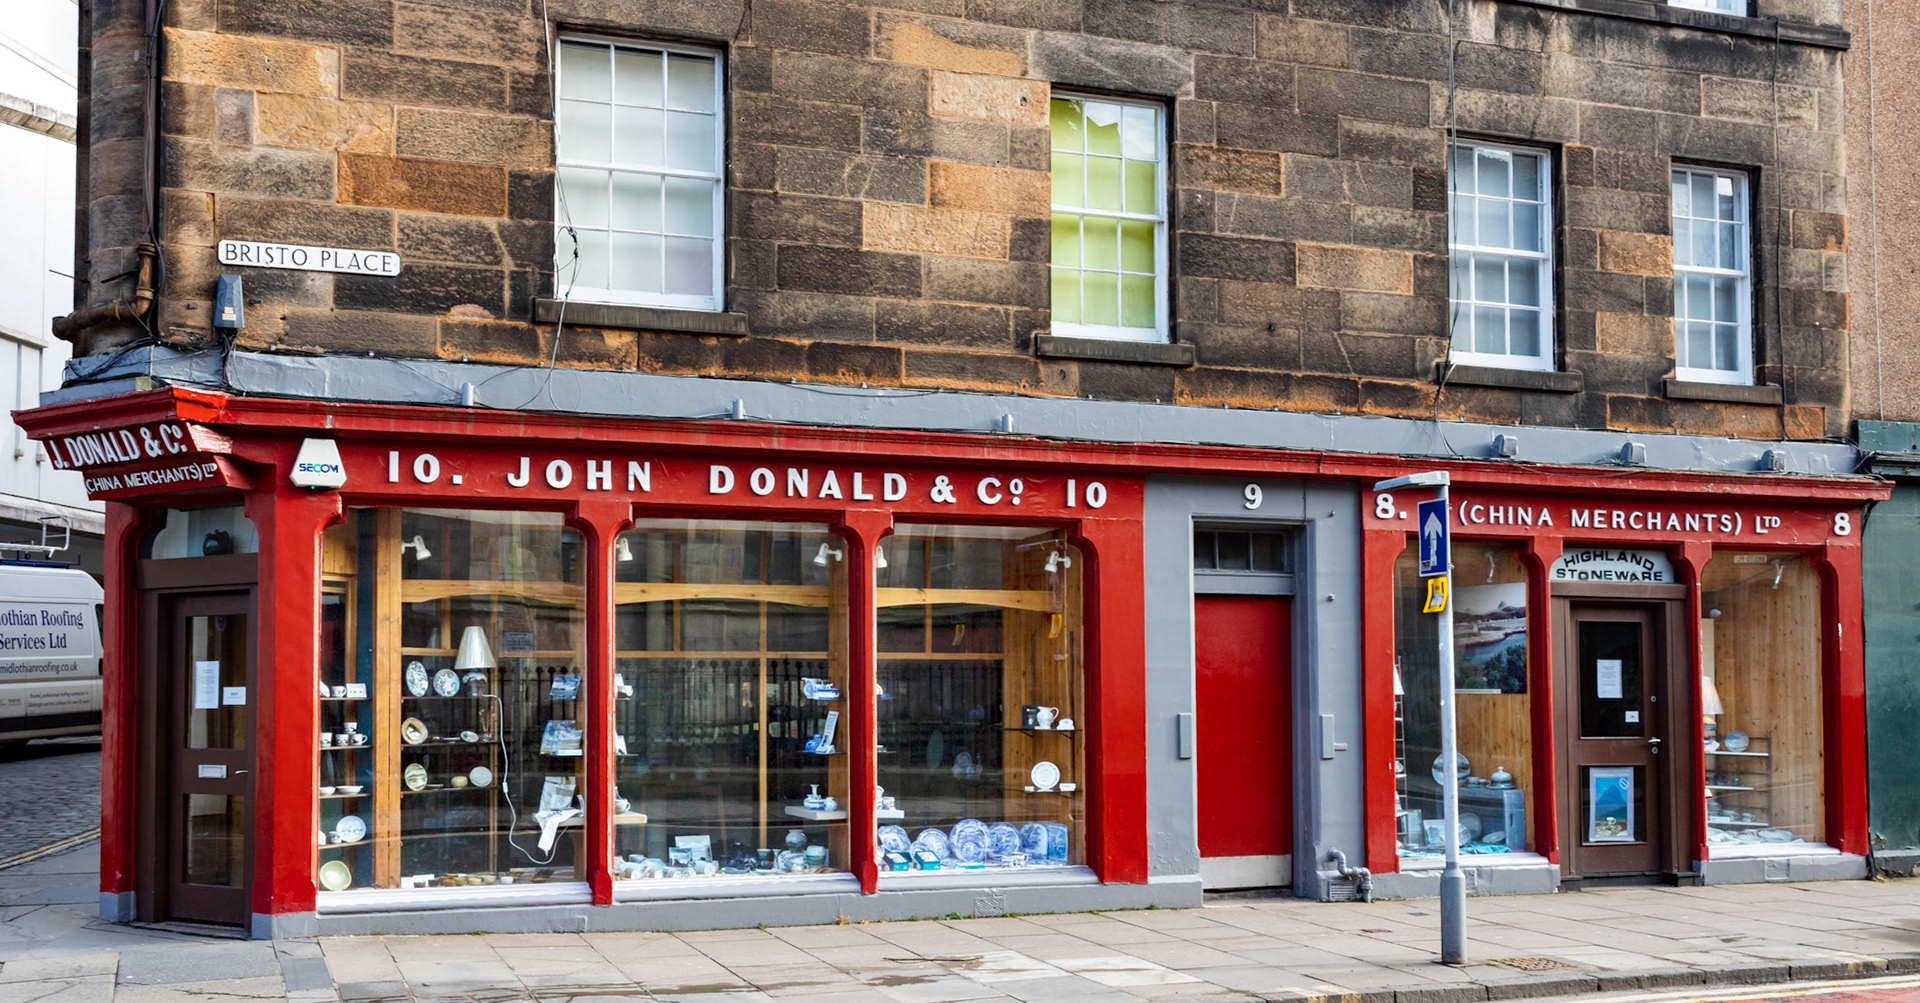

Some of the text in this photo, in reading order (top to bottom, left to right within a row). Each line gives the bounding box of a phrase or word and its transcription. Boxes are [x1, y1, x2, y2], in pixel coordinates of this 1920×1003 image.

[225, 243, 392, 272] BRISTO PLACE
[50, 440, 70, 469] J.
[64, 429, 141, 467] DONALD
[140, 426, 163, 458] &
[84, 476, 122, 494] (CHINA
[123, 462, 201, 488] MERCHANTS)
[299, 463, 339, 474] SECOM
[388, 451, 463, 485] 10.
[507, 457, 651, 492] JOHN
[709, 465, 907, 501] DONALD
[930, 475, 956, 503] &
[1066, 479, 1108, 508] 10
[1243, 483, 1263, 510] 9
[1376, 493, 1407, 520] 8.
[1459, 500, 1553, 527] (CHINA
[1571, 508, 1743, 536] MERCHANTS)
[1833, 512, 1851, 537] 8
[1563, 550, 1655, 572] HIGHLAND
[1556, 568, 1663, 582] STONEWARE
[41, 609, 84, 630] Roofing
[48, 632, 68, 649] Ltd
